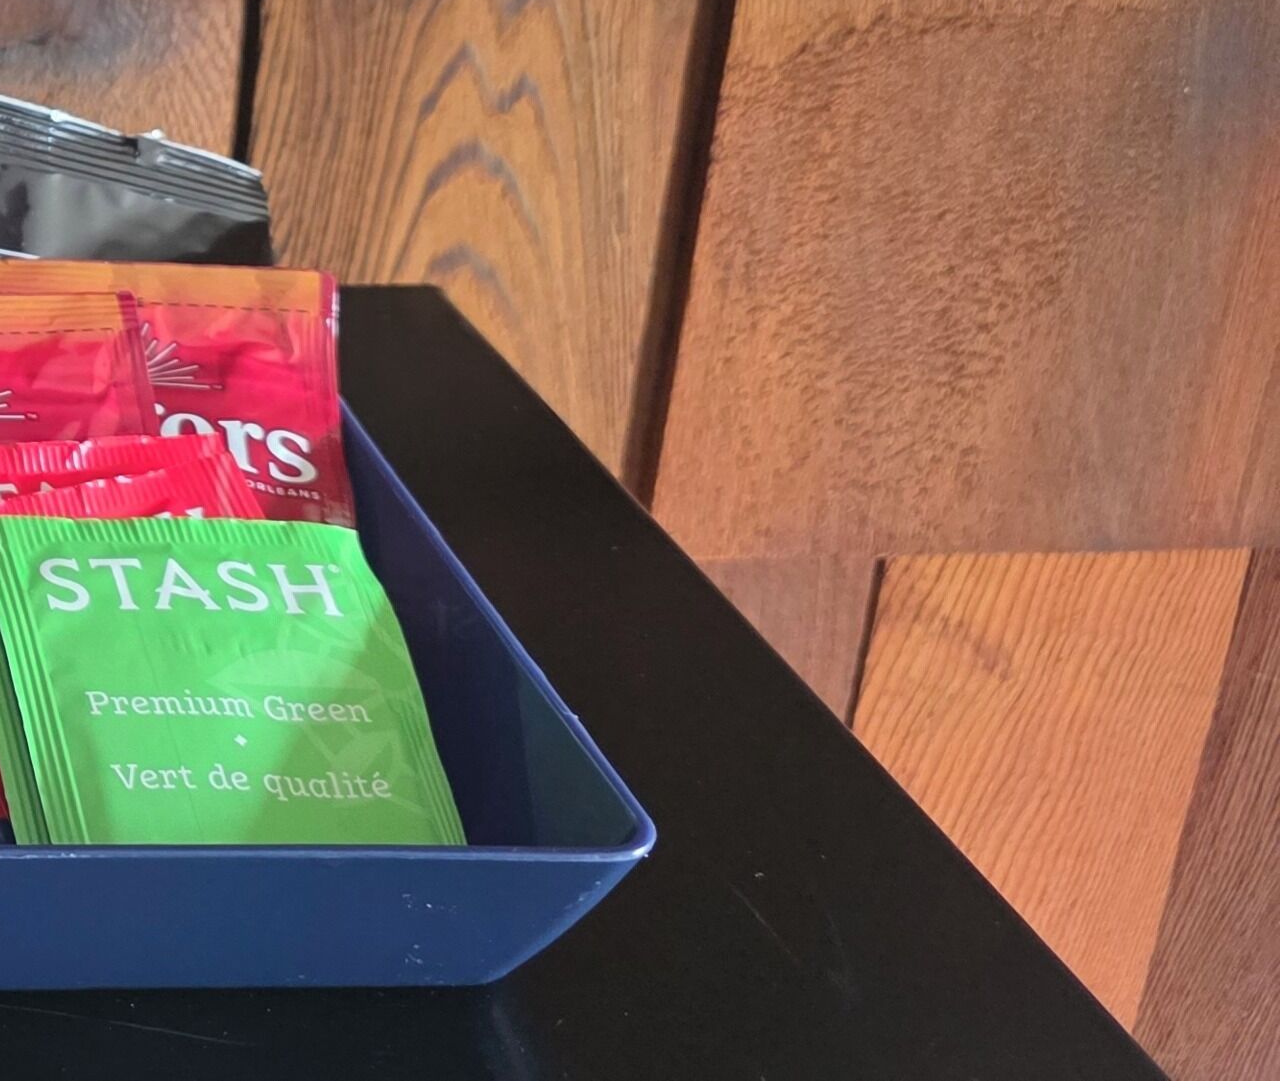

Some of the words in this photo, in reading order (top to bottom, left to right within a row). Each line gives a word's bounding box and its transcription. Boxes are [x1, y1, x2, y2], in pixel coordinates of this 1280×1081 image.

[39, 557, 345, 617] STASH
[85, 688, 255, 719] Premium
[263, 695, 372, 723] Green
[110, 763, 197, 790] Vert
[208, 763, 251, 790] de
[263, 770, 393, 802] qualité
